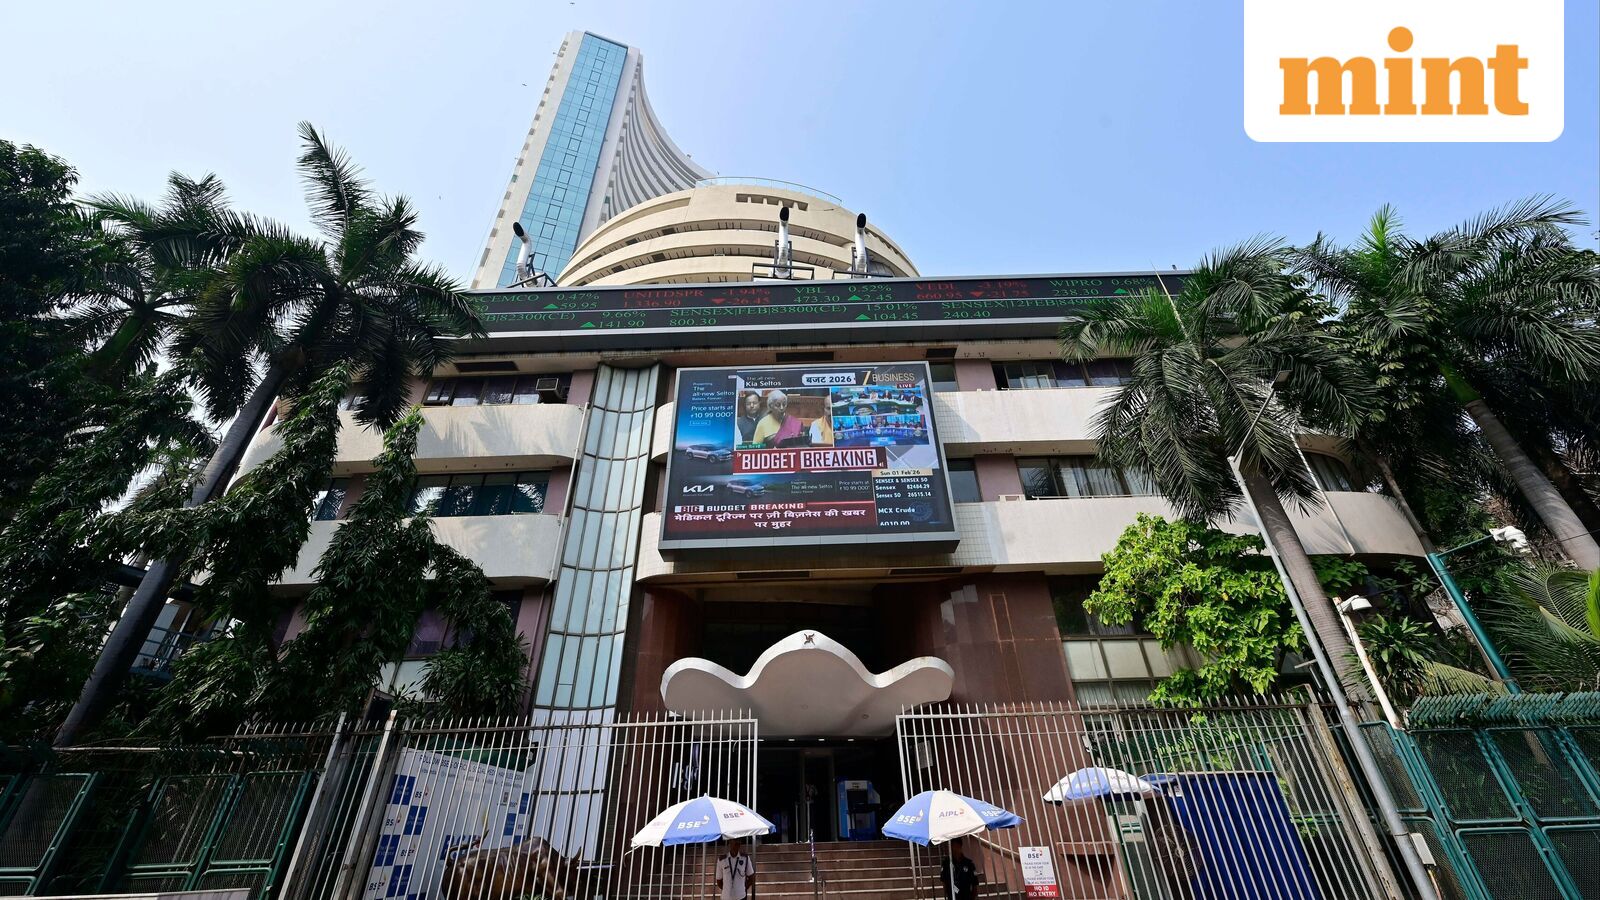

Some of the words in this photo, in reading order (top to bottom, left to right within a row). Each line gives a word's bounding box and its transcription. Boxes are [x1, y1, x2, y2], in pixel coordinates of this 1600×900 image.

[794, 295, 840, 303] 473.30
[1054, 288, 1099, 296] 238.30
[866, 303, 918, 311] 15.01%
[599, 320, 645, 328] 141.90
[669, 318, 717, 326] 800.30
[944, 311, 991, 319] 240.40
[872, 373, 915, 382] BUSINESS
[742, 453, 796, 469] BUDGET
[803, 450, 874, 468] BREAKING
[824, 509, 838, 517] की
[981, 809, 1001, 817] BSE
[897, 814, 917, 824] BSE
[677, 821, 700, 829] BSE
